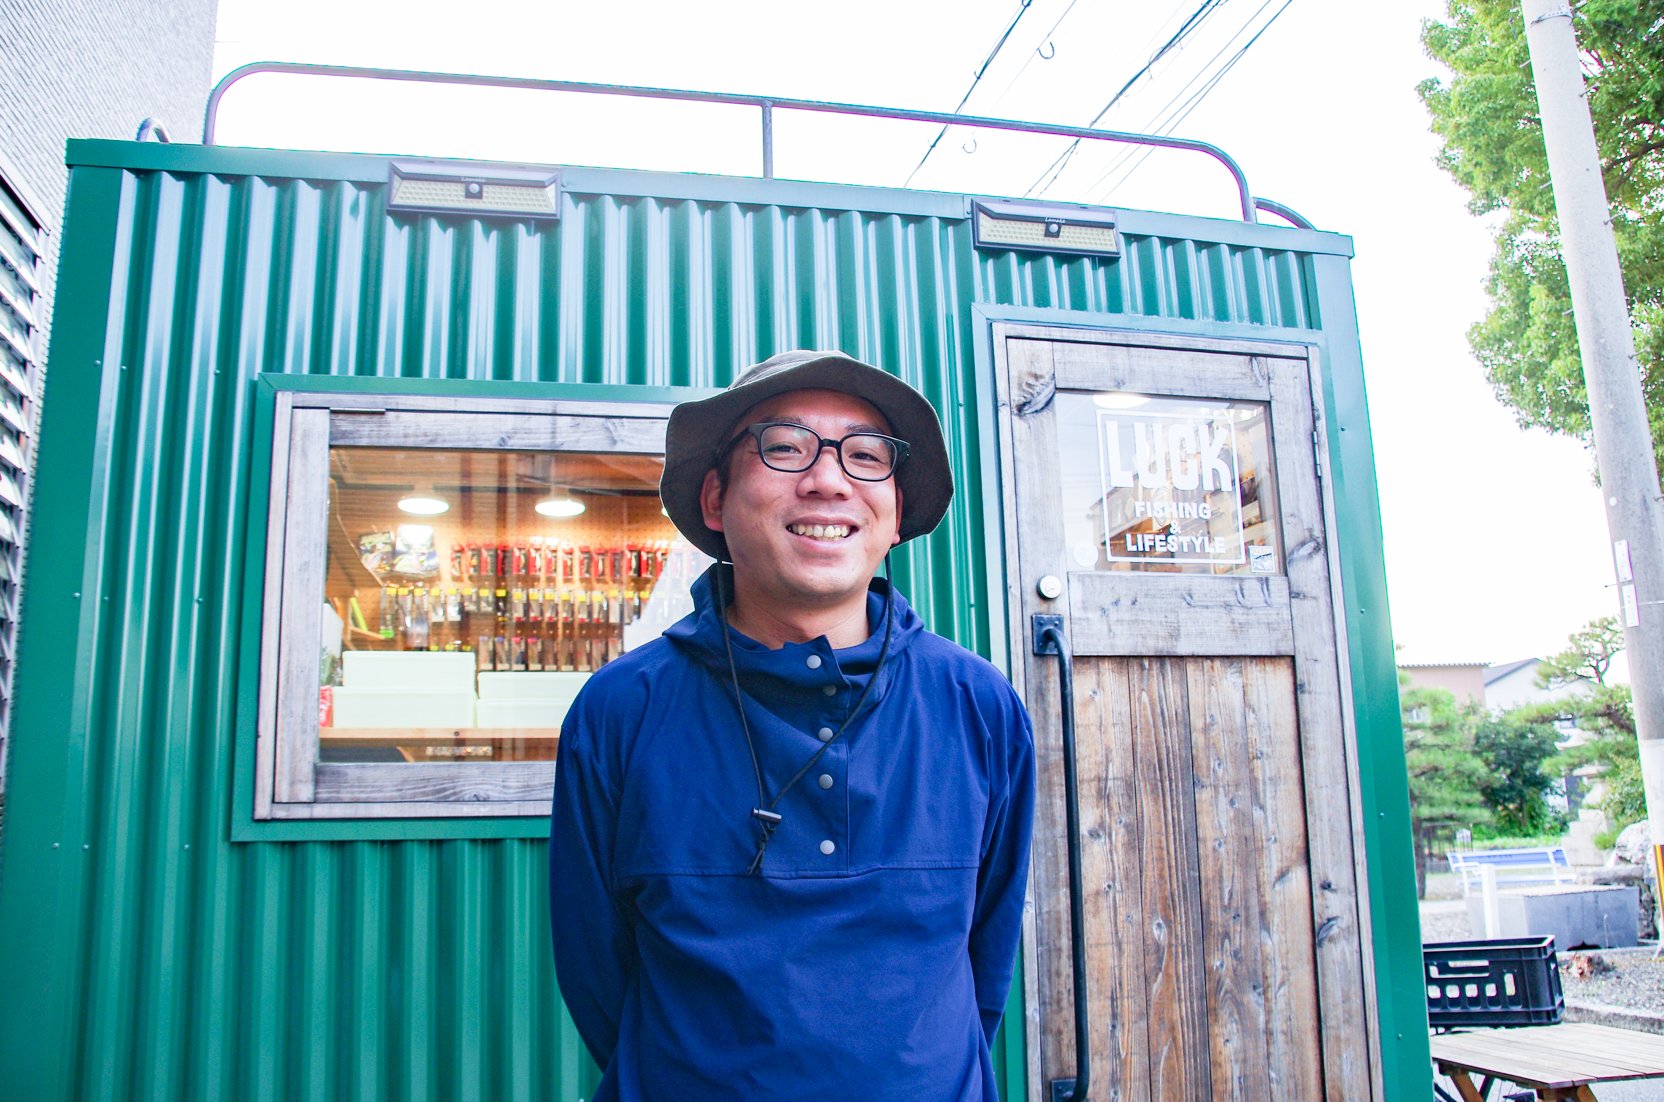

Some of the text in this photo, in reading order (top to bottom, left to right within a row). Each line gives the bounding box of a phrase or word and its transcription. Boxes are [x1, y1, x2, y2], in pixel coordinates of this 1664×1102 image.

[1106, 421, 1232, 491] LUCK
[1135, 501, 1211, 519] FISHING
[1169, 520, 1181, 534] &
[1126, 533, 1225, 553] LIFESTYLE
